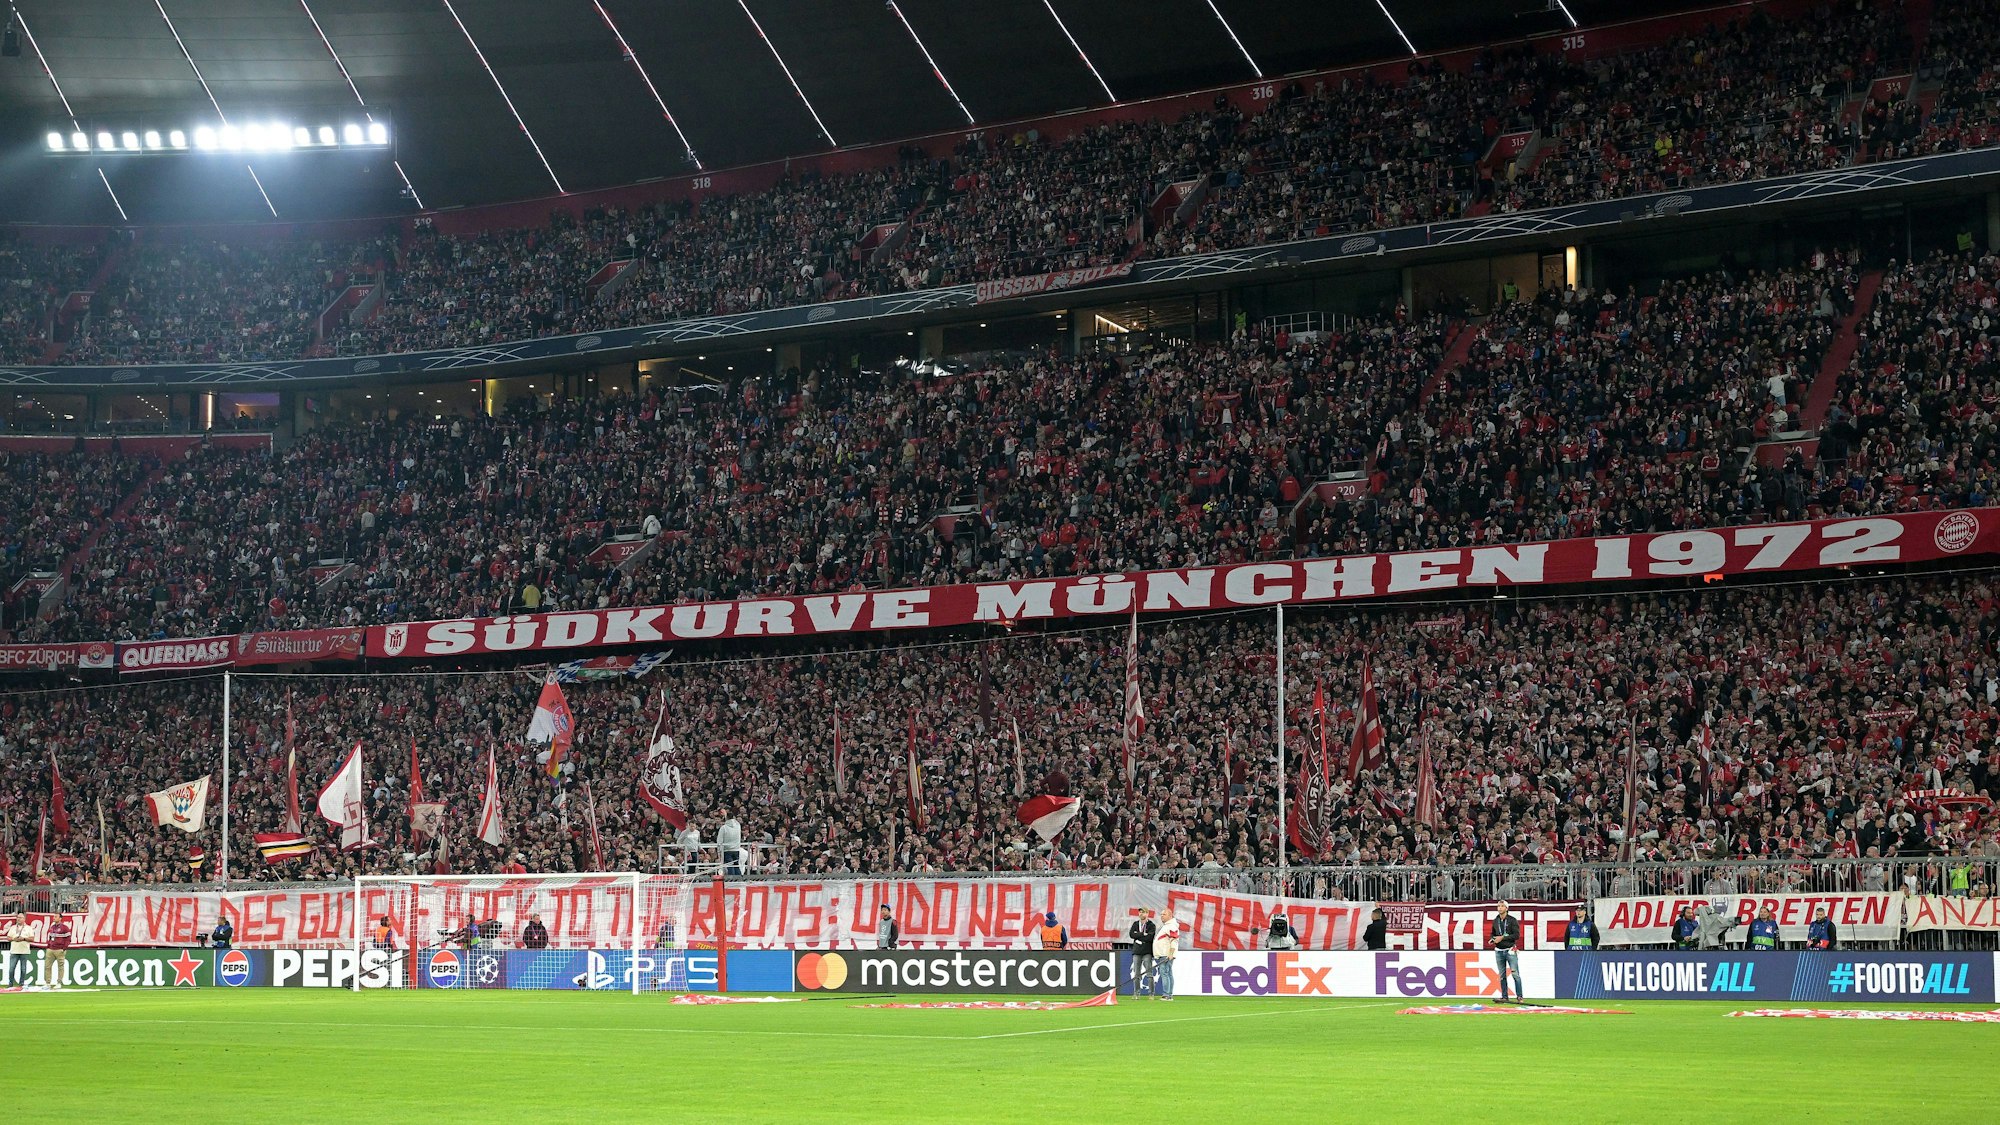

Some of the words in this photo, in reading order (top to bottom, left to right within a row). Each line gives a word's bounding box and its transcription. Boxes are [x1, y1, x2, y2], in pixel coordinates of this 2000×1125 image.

[1562, 35, 1585, 51] 315
[1252, 86, 1274, 100] 316
[1511, 138, 1525, 147] 315
[692, 177, 711, 190] 318
[976, 274, 1048, 303] GIESSEN
[1069, 262, 1135, 285] BULLS
[425, 589, 930, 655] SÜDKURVE
[973, 543, 1549, 621] MÜNCHEN
[1591, 518, 1904, 579] 1972
[26, 647, 76, 665] ZÜRICH
[122, 640, 230, 668] QUEERPASS
[255, 635, 323, 655] Südkurve
[326, 633, 347, 651] '73
[93, 896, 132, 942] ZU
[144, 896, 208, 943] VIEL
[220, 893, 287, 944] DES
[298, 889, 407, 940] GUTEN
[549, 887, 593, 937] TO
[969, 883, 1056, 938] NEW
[1070, 884, 1121, 938] CL
[1384, 913, 1424, 924] UNGS!
[1736, 896, 1890, 926] BRETTEN
[223, 964, 248, 972] PEPSI
[273, 949, 403, 987] PEPSI
[431, 965, 458, 973] PEPSI
[624, 957, 719, 984] PS5
[861, 952, 1116, 988] mastercard
[1201, 952, 1333, 995] FedEx
[1375, 952, 1515, 997] FedEx
[1601, 962, 1708, 992] WELCOME
[1709, 962, 1757, 992] ALL
[1828, 962, 1971, 994] #FOOTBALL
